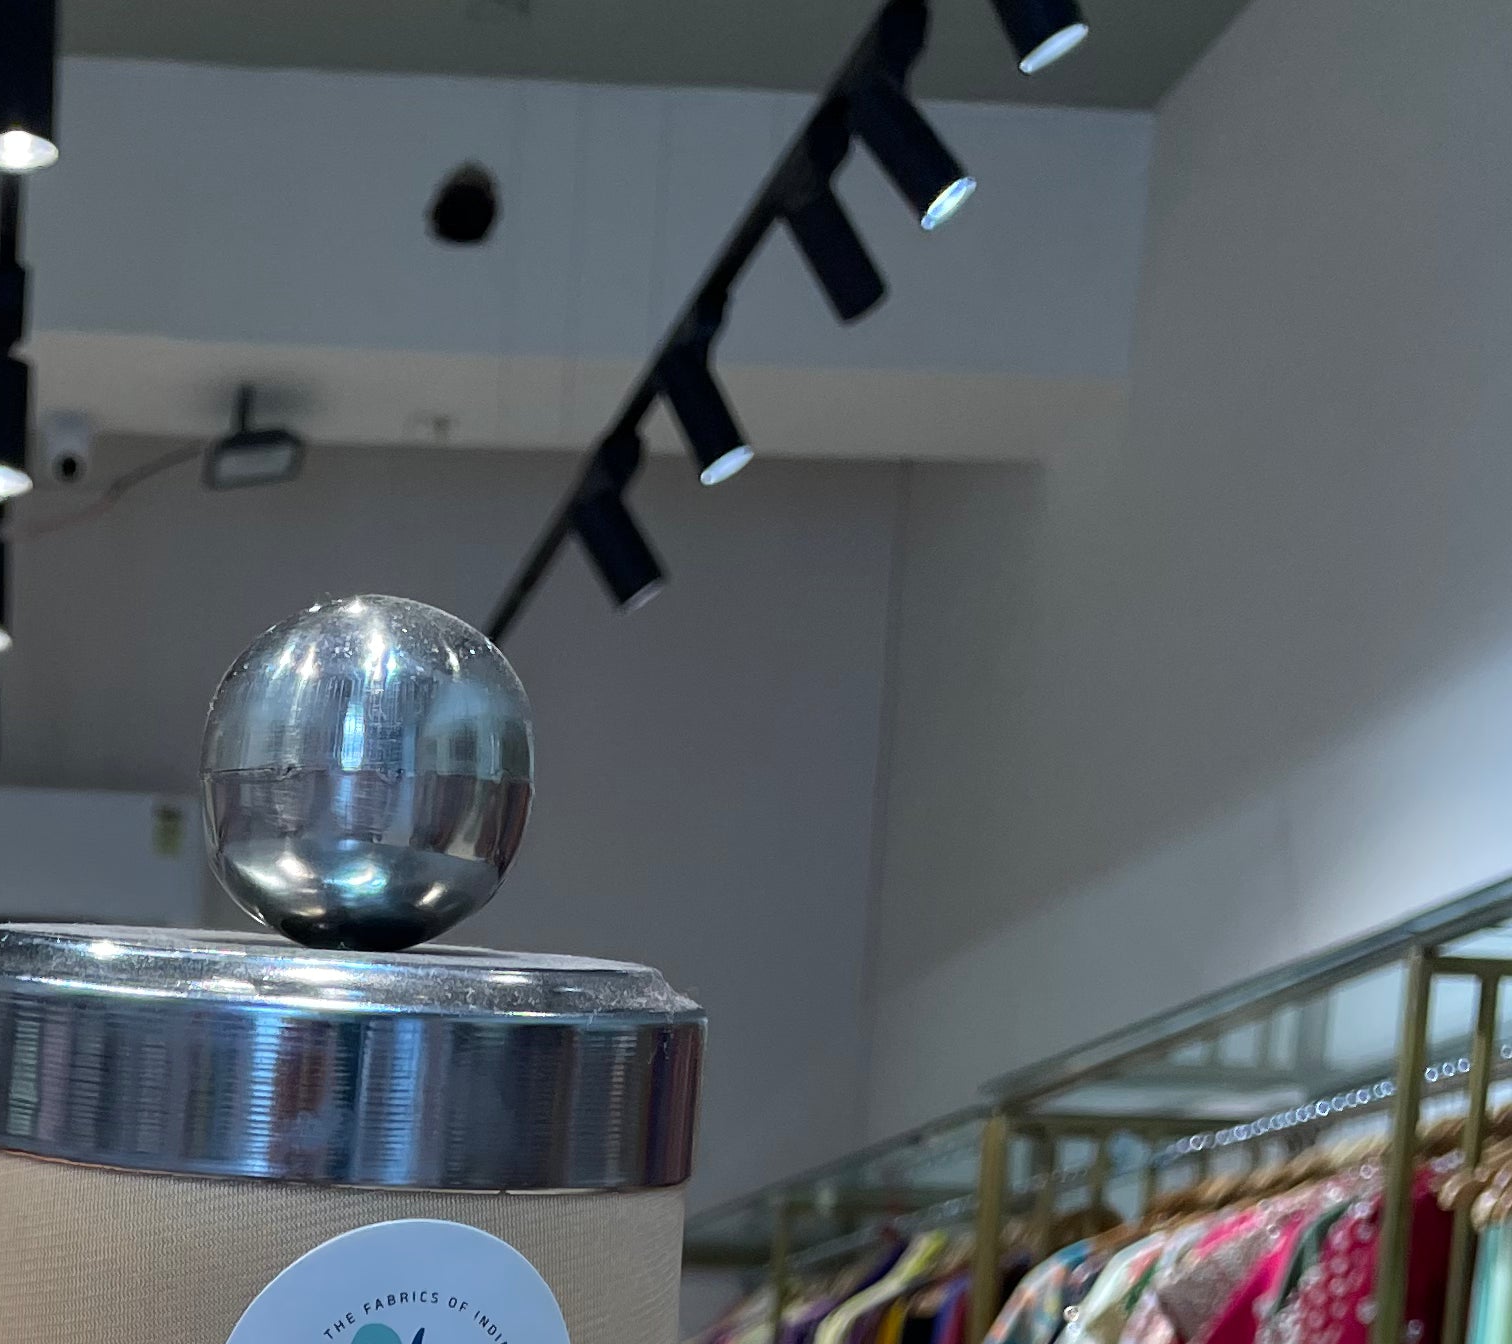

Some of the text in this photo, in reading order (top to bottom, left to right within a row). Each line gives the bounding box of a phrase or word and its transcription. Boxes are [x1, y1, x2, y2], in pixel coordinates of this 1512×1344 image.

[323, 1312, 356, 1339] THE
[363, 1291, 439, 1315] FABRICS
[448, 1296, 469, 1312] OF
